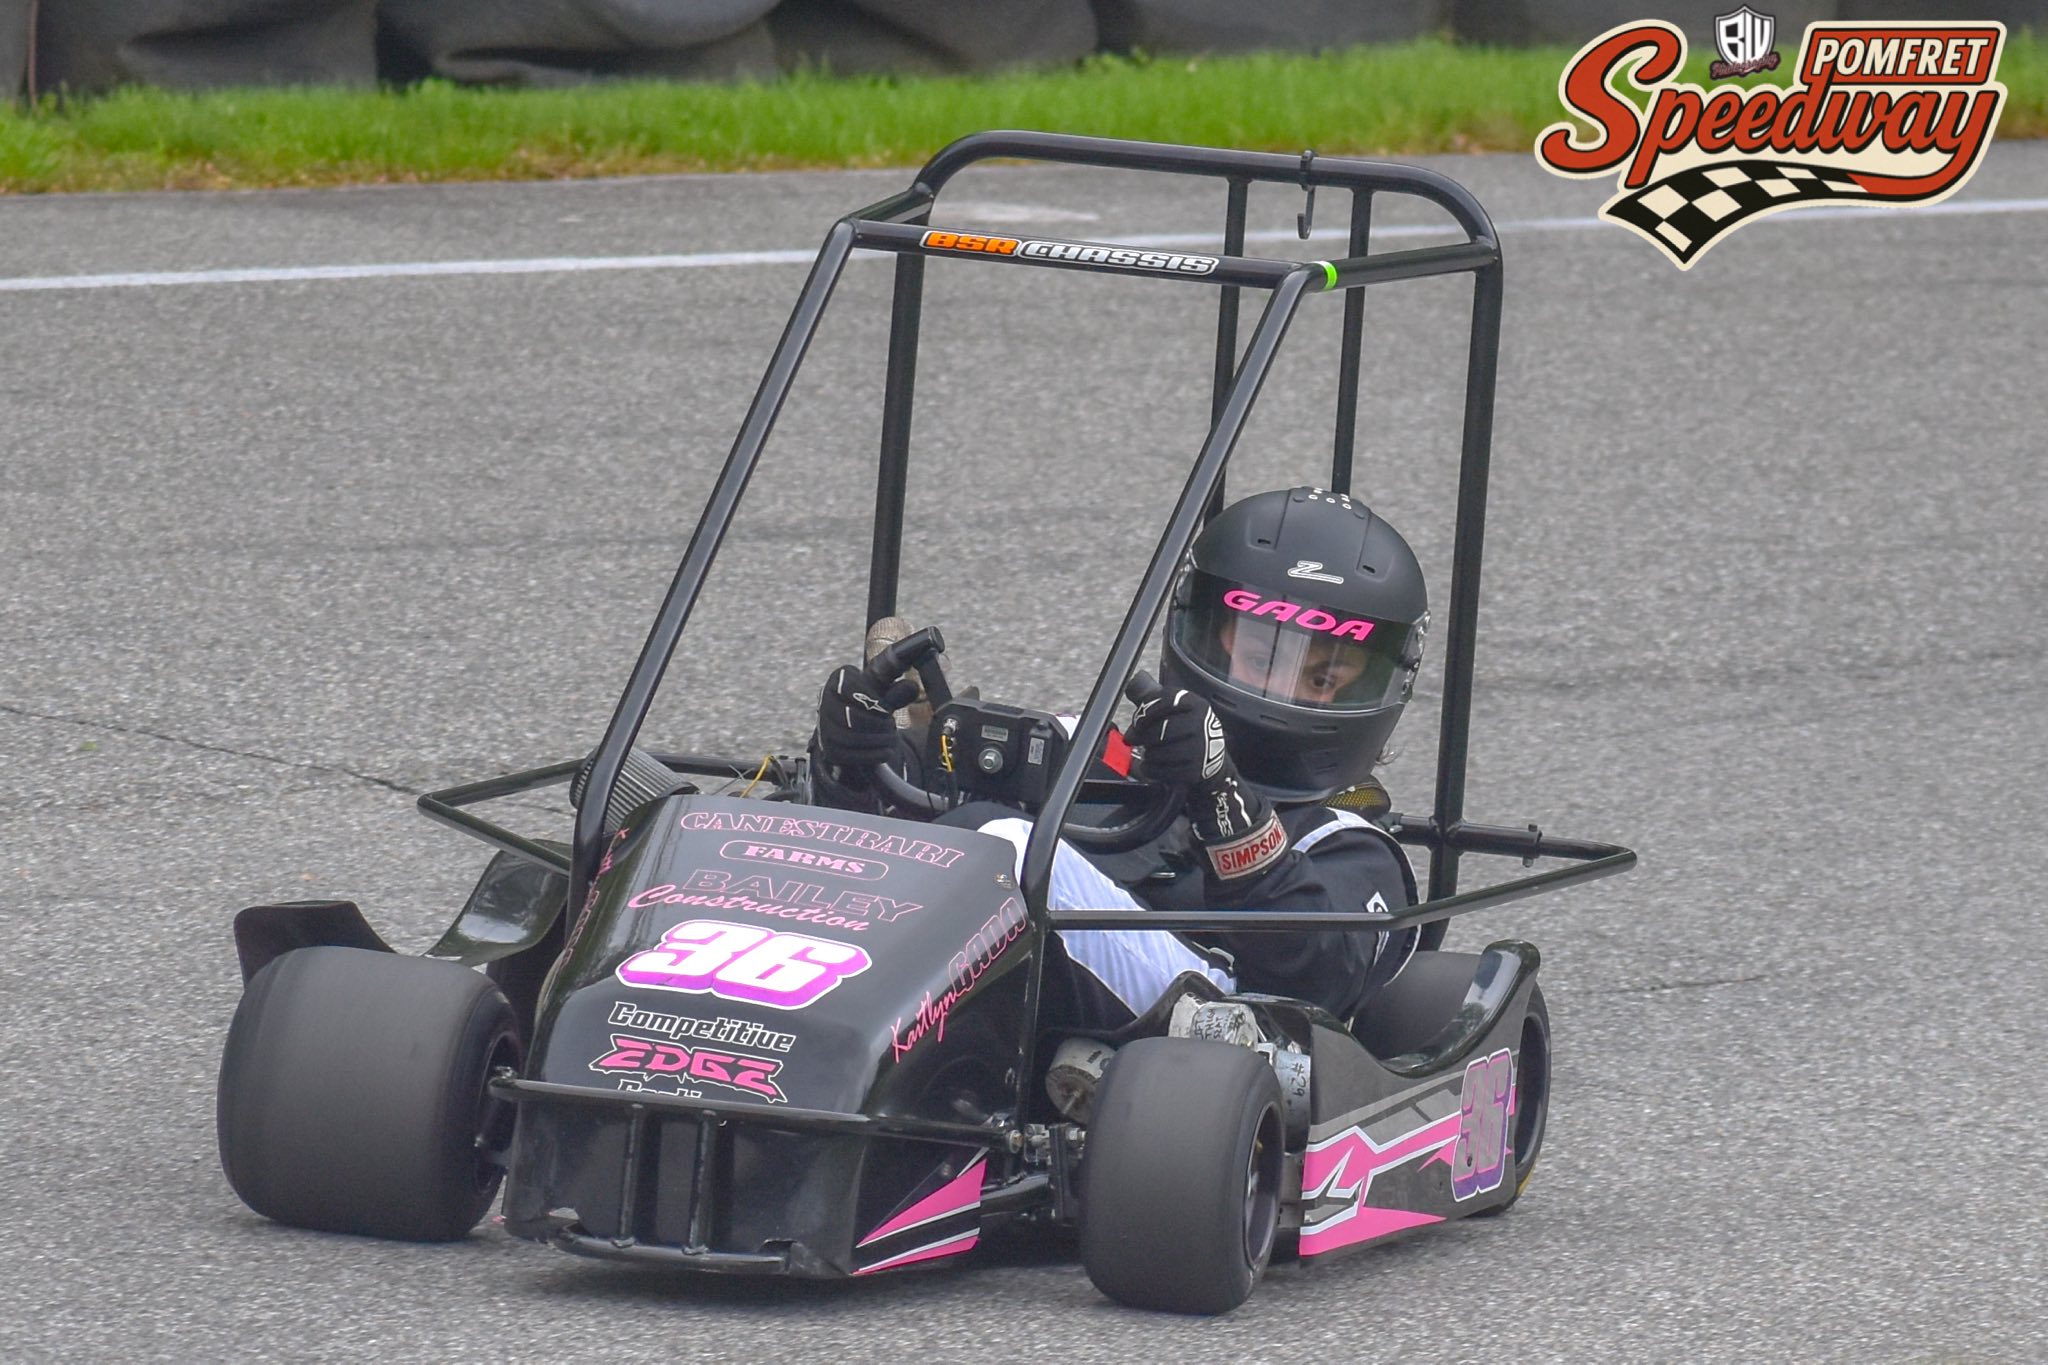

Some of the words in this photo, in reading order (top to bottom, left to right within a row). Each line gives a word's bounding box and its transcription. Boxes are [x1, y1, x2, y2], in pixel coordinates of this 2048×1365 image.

[924, 231, 1019, 255] BSR
[1022, 240, 1217, 274] CHASSIS
[1223, 589, 1376, 642] GADA
[680, 811, 966, 869] CANESTRARI
[743, 844, 866, 875] FARMS
[1220, 822, 1283, 871] SIMPSON
[627, 883, 870, 931] Construction
[682, 868, 924, 923] BAILEY
[614, 918, 873, 1011] 36
[890, 990, 957, 1064] Kaitlyn
[949, 896, 1027, 998] GADA
[607, 1000, 797, 1053] Competitive
[597, 1037, 779, 1098] EDGE
[1451, 1047, 1514, 1203] 36
